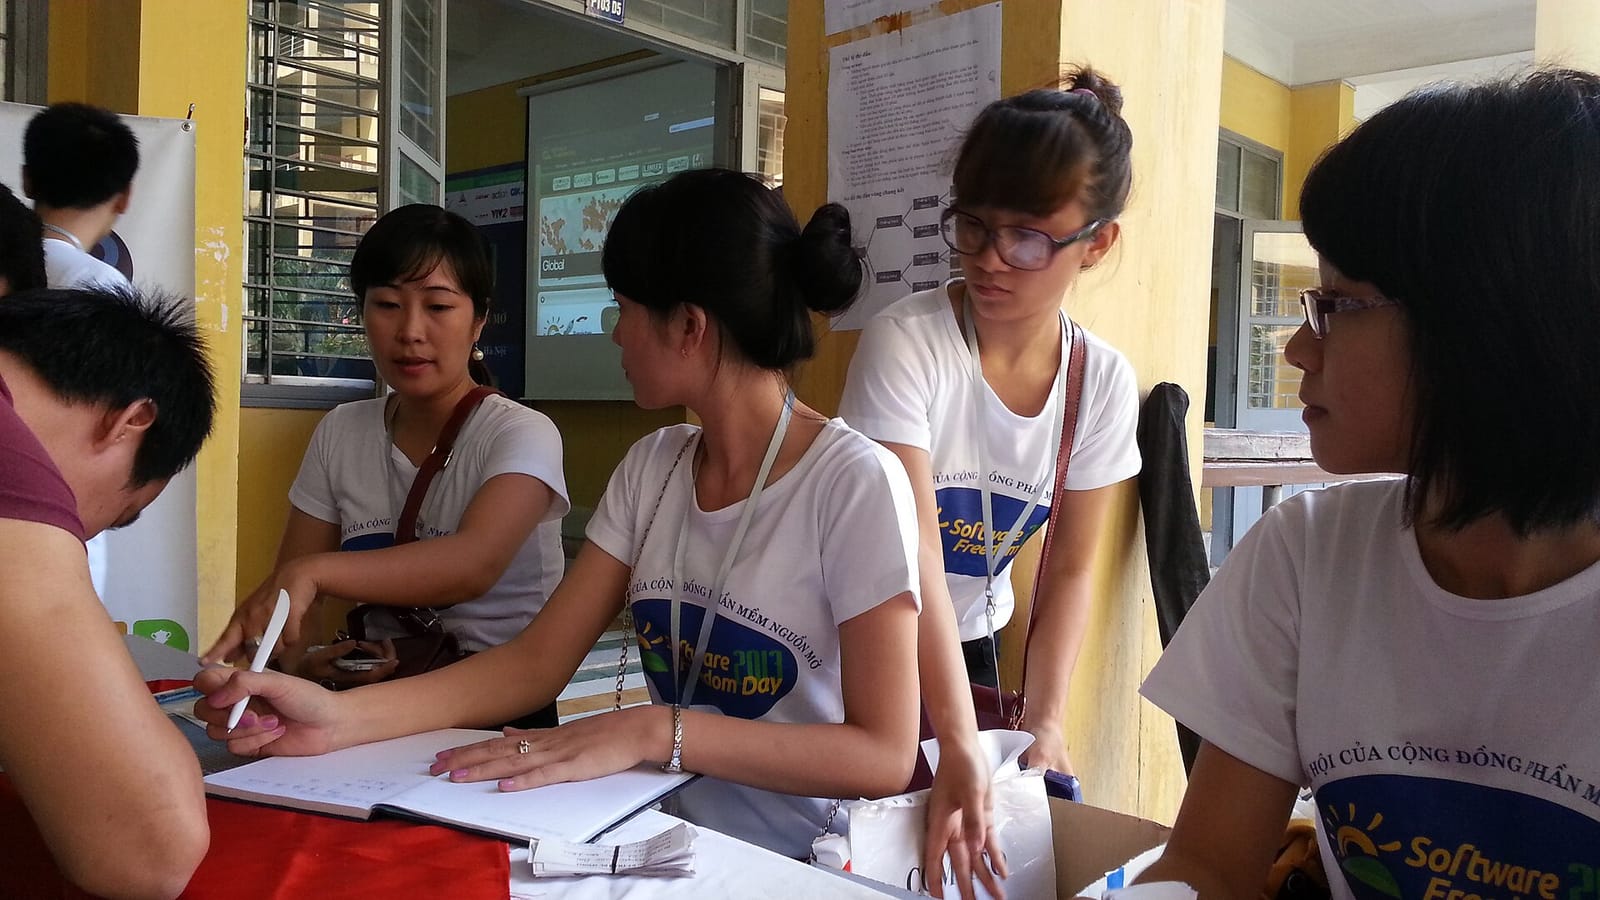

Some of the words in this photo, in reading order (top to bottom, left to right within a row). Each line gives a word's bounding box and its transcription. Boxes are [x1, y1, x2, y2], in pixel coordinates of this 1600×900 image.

[611, 0, 622, 16] D5
[542, 259, 566, 271] Global
[988, 470, 1014, 487] ỒNG
[949, 519, 1024, 541] Softwae
[952, 538, 1021, 556] Freedm
[650, 577, 674, 592] CỘN
[736, 604, 769, 628] MỀM
[769, 623, 811, 652] NGUỒN
[741, 674, 784, 696] Day
[1309, 752, 1334, 778] HỘI
[1339, 740, 1385, 765] CỦA
[1387, 740, 1450, 767] CỘNG
[1455, 744, 1522, 773] ĐỒNG
[1404, 836, 1560, 900] Software
